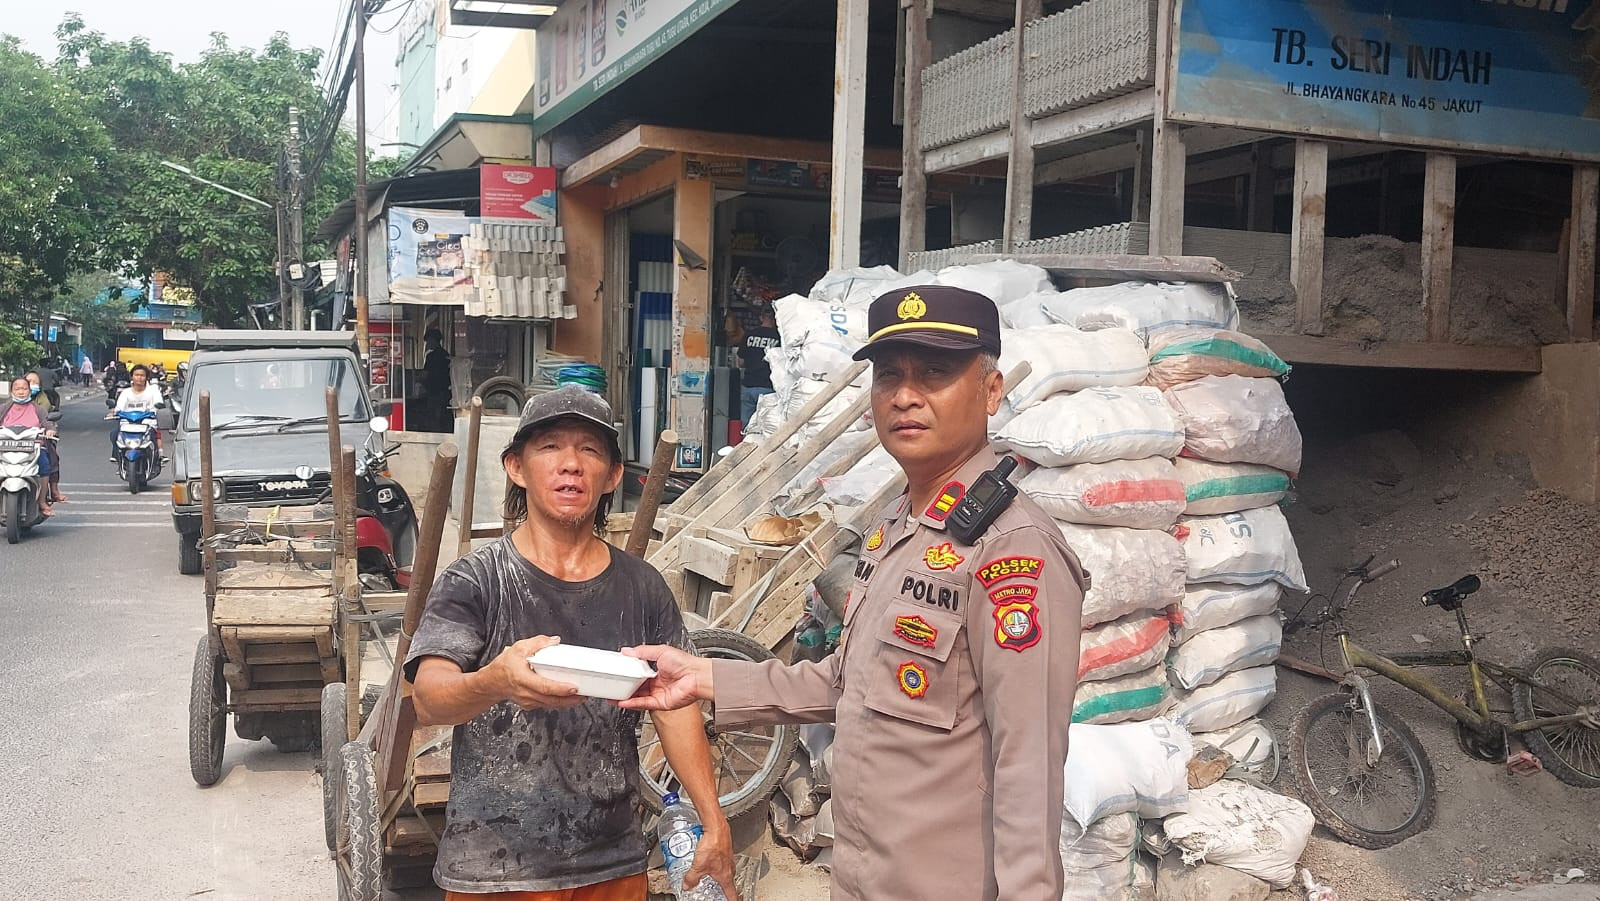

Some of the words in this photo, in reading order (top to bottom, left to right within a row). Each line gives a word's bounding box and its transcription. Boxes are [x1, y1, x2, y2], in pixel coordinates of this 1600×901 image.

[1271, 27, 1313, 67] TB.
[1330, 34, 1392, 76] SERI
[1406, 44, 1492, 85] INDAH
[1442, 97, 1484, 114] JAKUT
[746, 336, 779, 348] CREW
[257, 480, 309, 491] TOYOTA
[981, 559, 1039, 579] POLSEK
[989, 566, 1031, 580] KOJA
[900, 575, 959, 611] POLRI
[1016, 587, 1032, 596] JAYA
